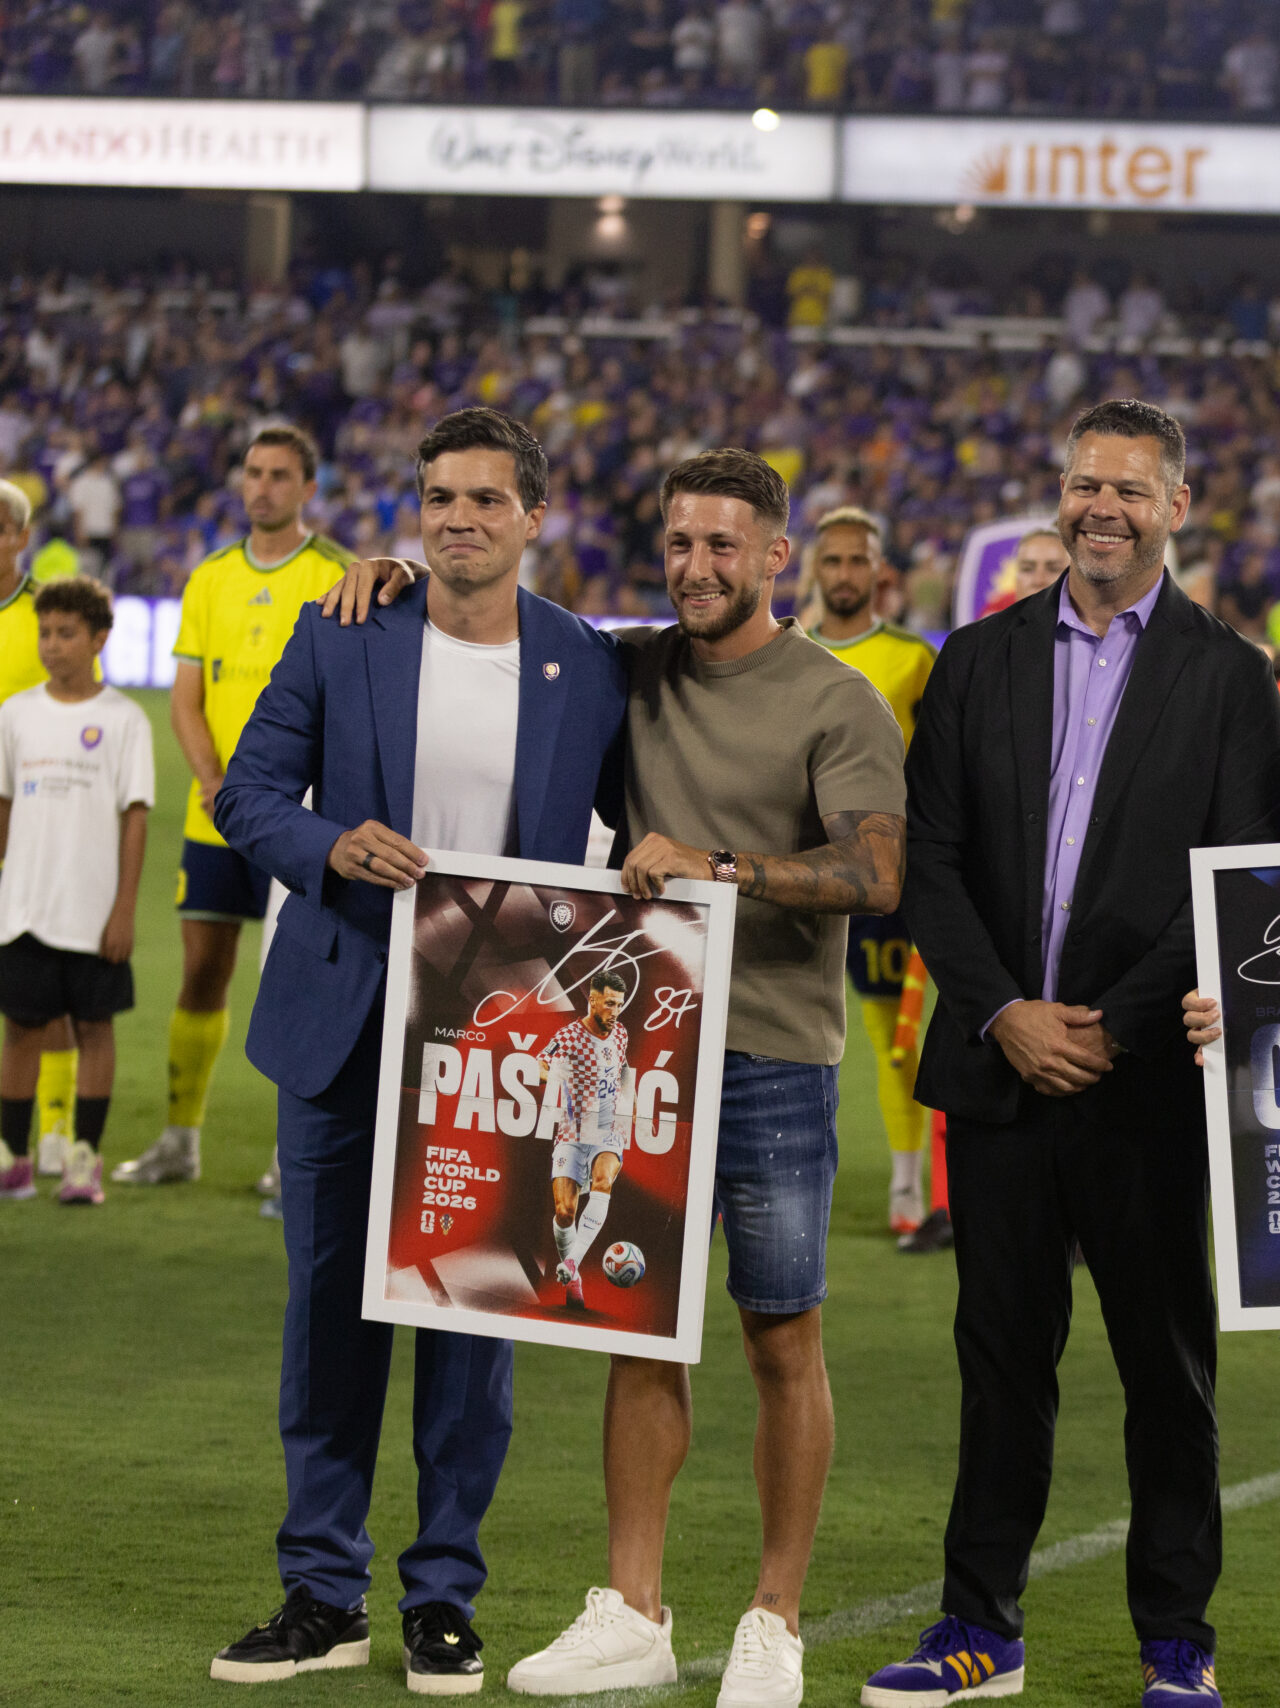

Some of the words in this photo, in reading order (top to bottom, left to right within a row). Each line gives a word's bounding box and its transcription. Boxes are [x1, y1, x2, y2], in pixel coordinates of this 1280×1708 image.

[1026, 137, 1212, 200] inter
[860, 939, 910, 984] 10
[434, 1026, 487, 1043] MARCO
[426, 1145, 472, 1164] FIFA
[425, 1160, 501, 1182] WORLD
[423, 1176, 467, 1193] CUP
[422, 1191, 477, 1210] 2026
